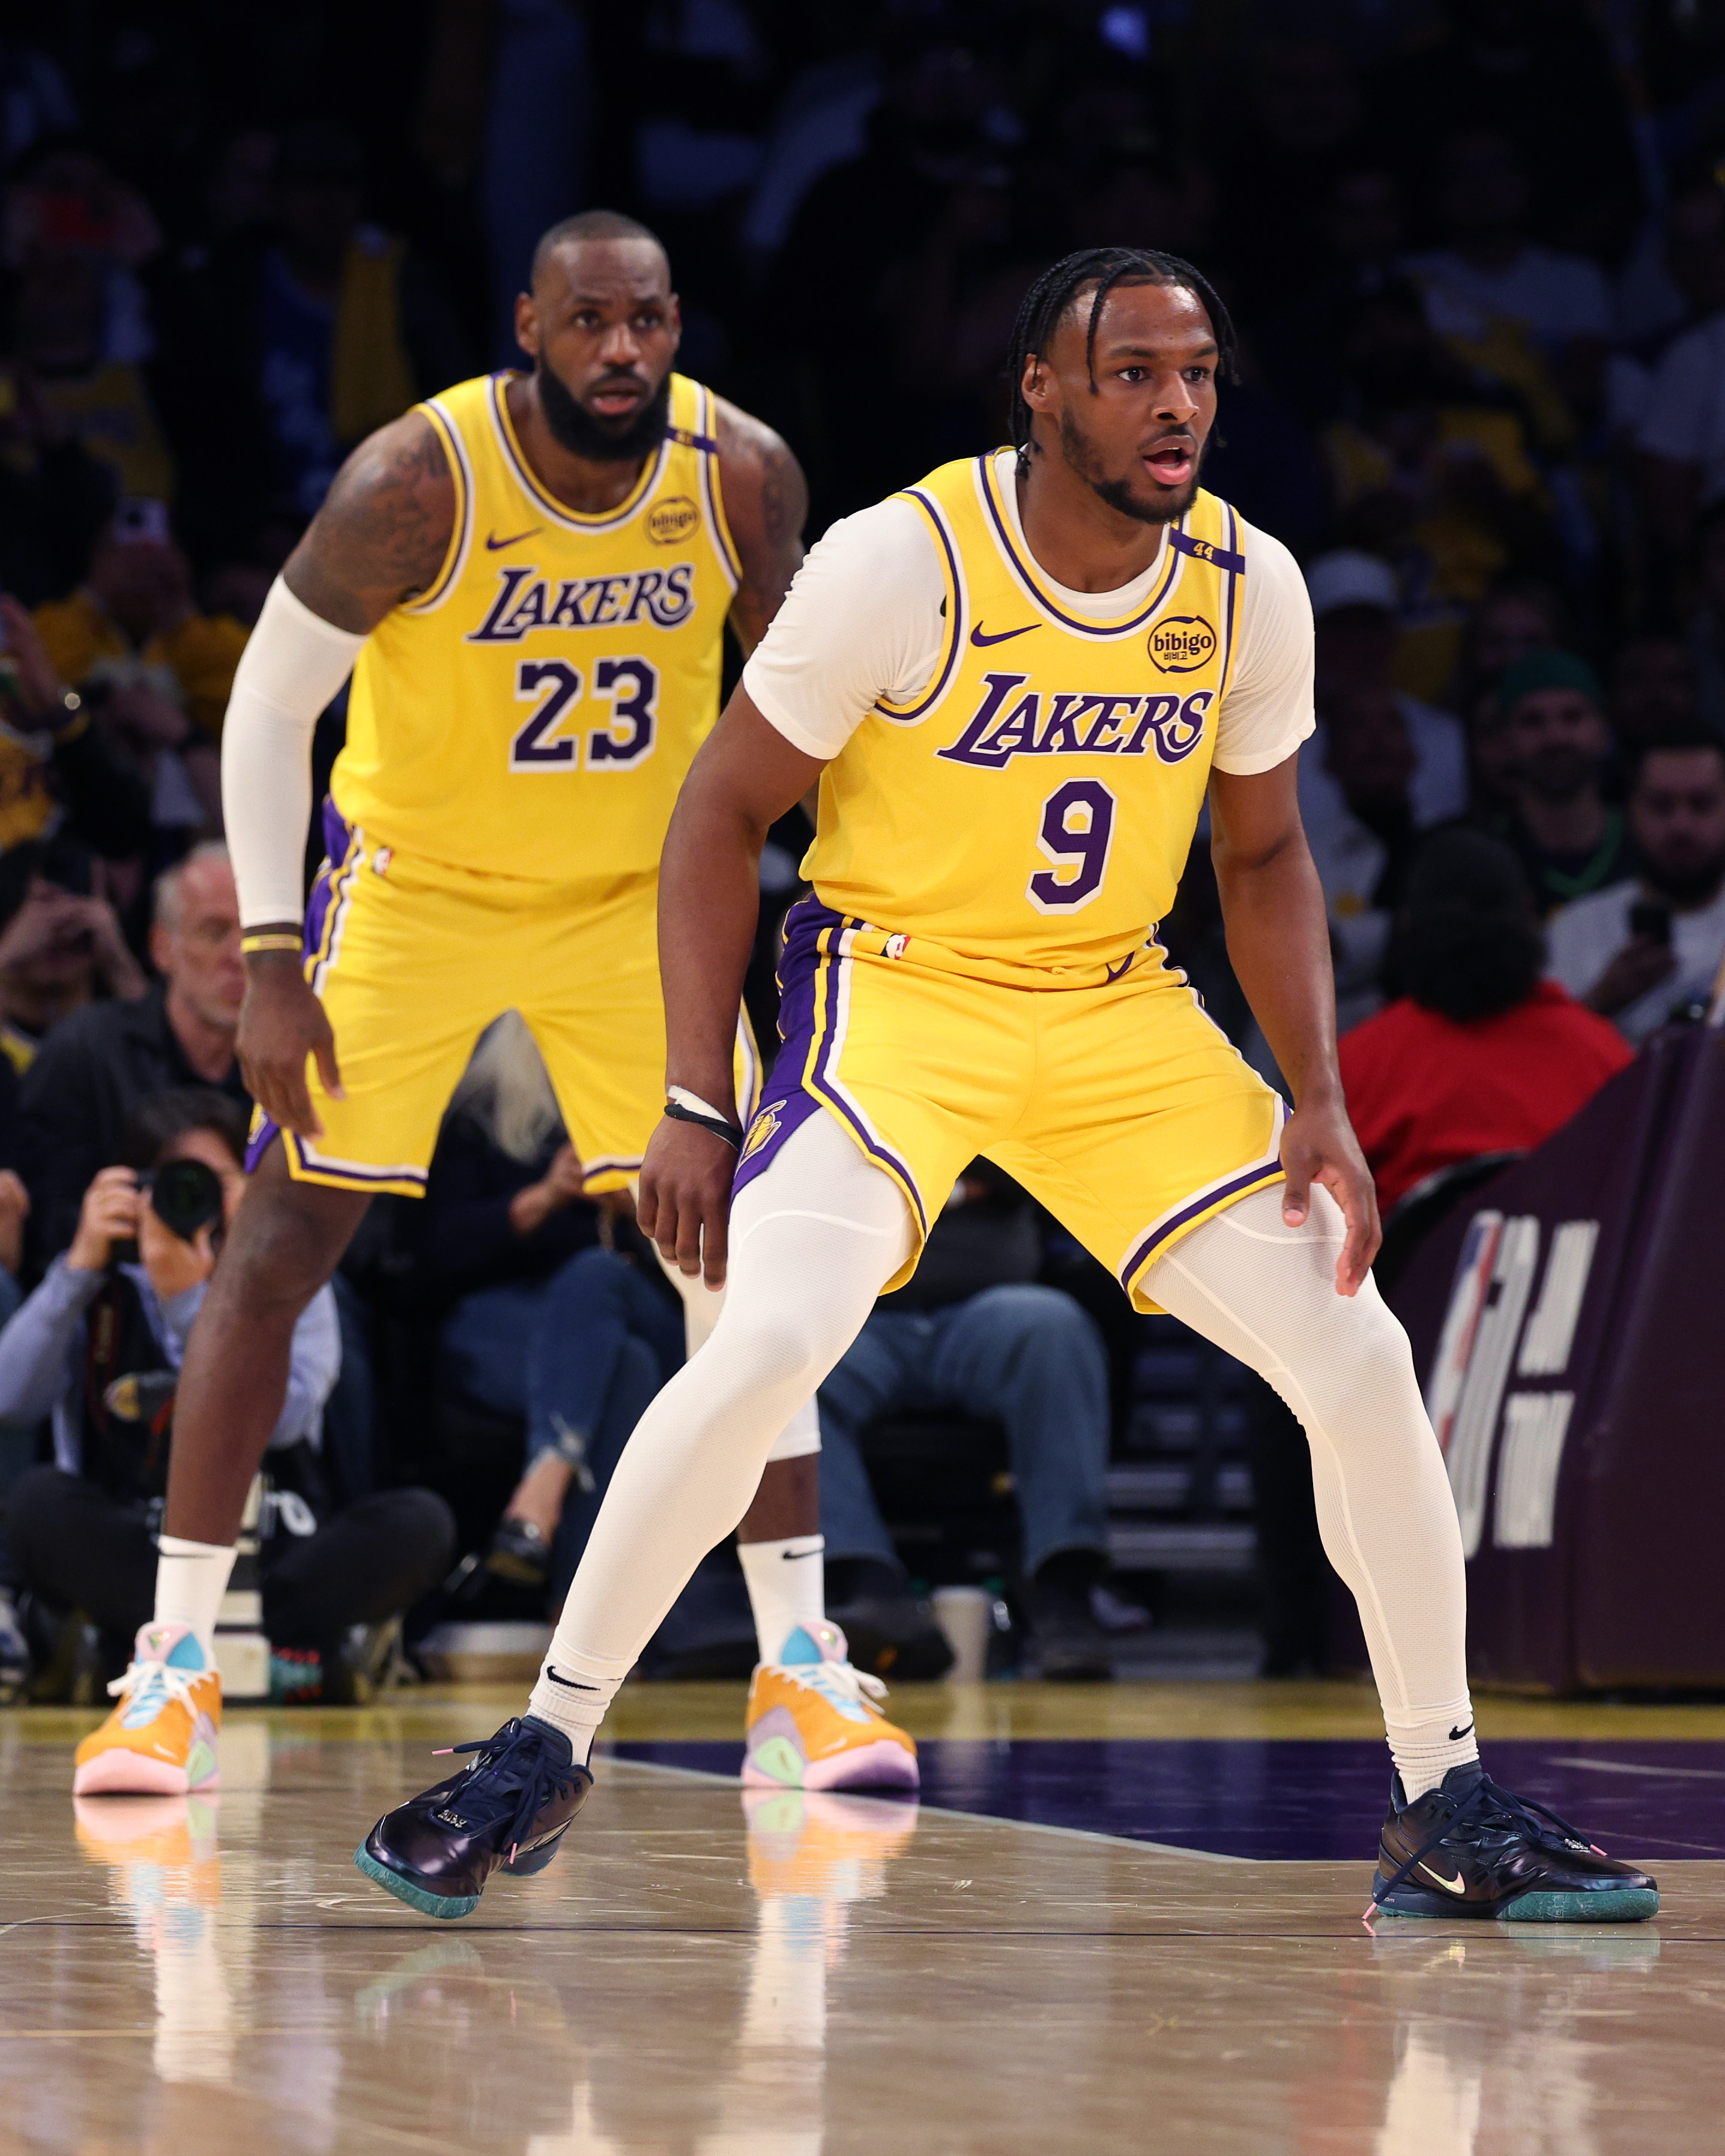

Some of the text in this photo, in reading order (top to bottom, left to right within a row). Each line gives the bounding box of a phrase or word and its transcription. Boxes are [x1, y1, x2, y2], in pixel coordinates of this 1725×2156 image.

[1193, 542, 1215, 560] 44
[465, 564, 695, 642] LAKERS
[1154, 631, 1212, 655] bibigo
[1163, 651, 1188, 661] 비비고
[511, 656, 658, 772] 23
[934, 671, 1217, 770] LAKERS
[1026, 778, 1117, 915] 9
